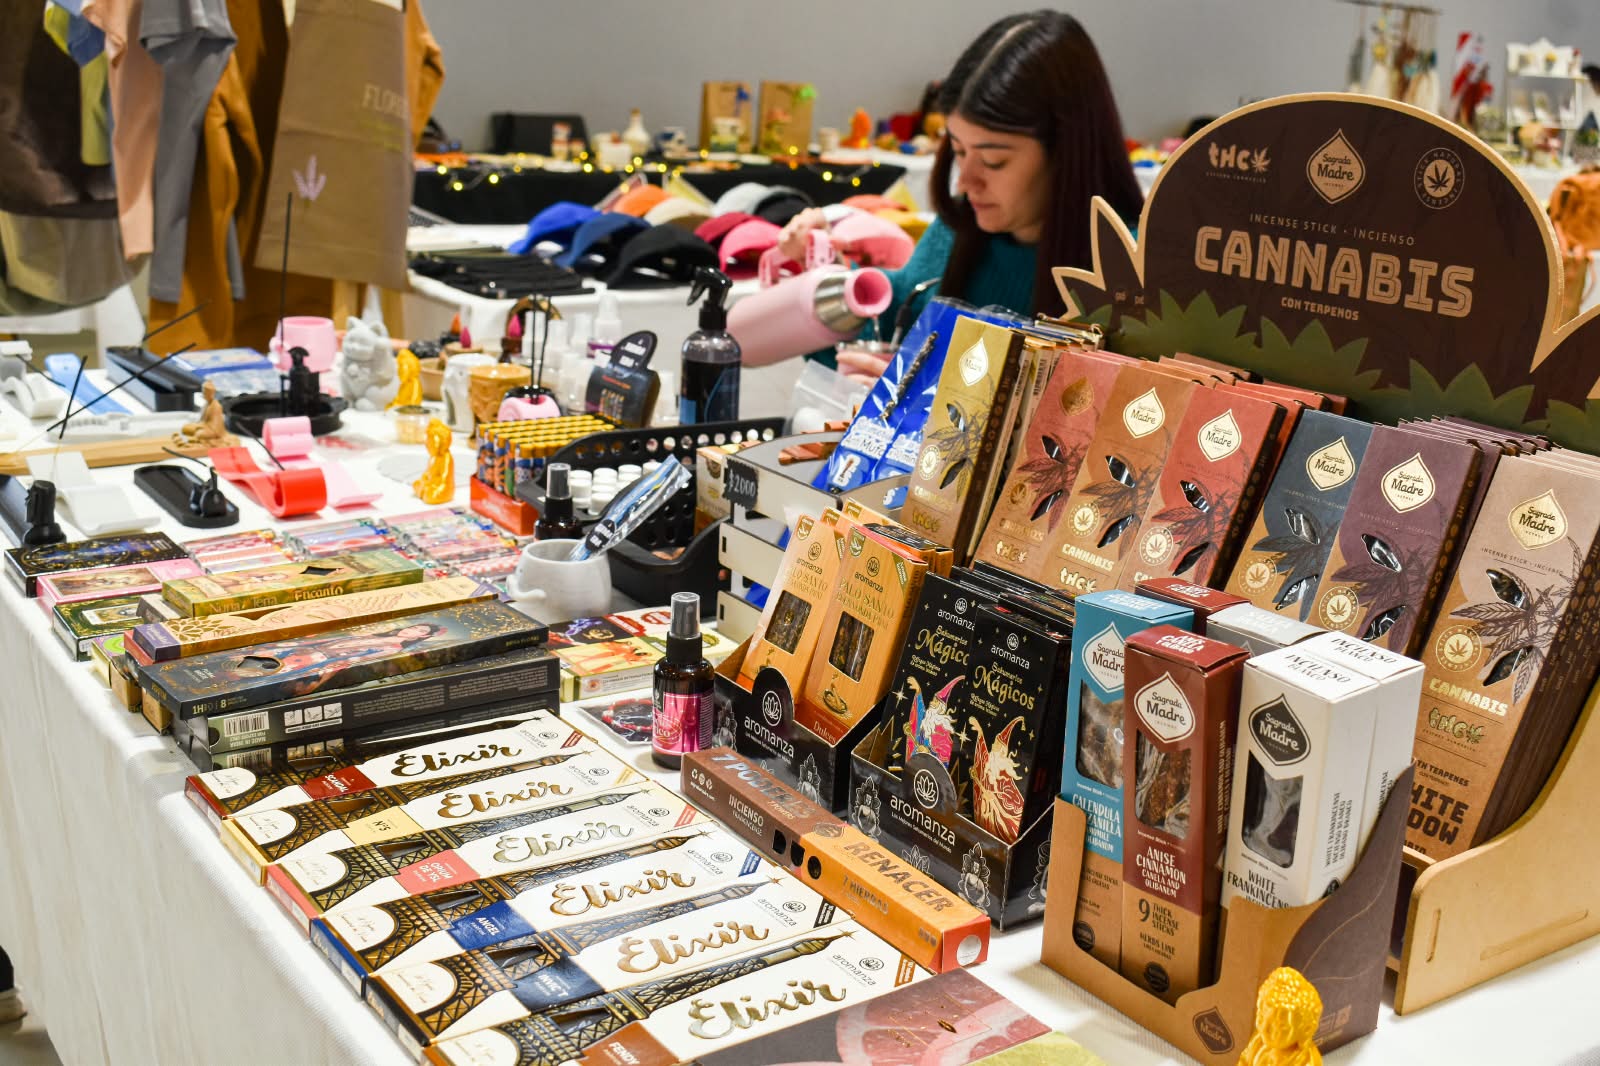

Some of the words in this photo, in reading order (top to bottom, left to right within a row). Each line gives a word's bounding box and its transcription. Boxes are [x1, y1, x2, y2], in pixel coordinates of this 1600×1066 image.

[1317, 164, 1354, 181] Madre
[1250, 213, 1298, 229] INCENSE
[1303, 220, 1338, 234] STICK
[1353, 228, 1415, 246] INCIENSO
[1194, 225, 1475, 318] CANNABIS
[1281, 297, 1301, 310] CON
[1303, 300, 1360, 321] TERPENOS
[1130, 409, 1156, 425] Madre
[1205, 431, 1232, 448] Madre
[1315, 459, 1345, 476] Madre
[727, 472, 757, 498] $2000
[1391, 478, 1424, 497] Madre
[1519, 513, 1556, 534] Madre
[1528, 506, 1555, 521] Sagrada
[1062, 543, 1114, 572] CANNABIS
[855, 571, 884, 593] aromanza
[990, 644, 1030, 670] aromanza
[1092, 651, 1125, 674] Madre
[1285, 654, 1351, 683] INCIENSO
[972, 665, 1035, 710] Mágicos
[1151, 691, 1182, 709] Sagrada
[1429, 677, 1509, 717] CANNABIS
[1146, 700, 1187, 726] Madre
[1265, 712, 1296, 734] Sagrada
[744, 715, 795, 759] aromanza
[813, 720, 836, 745] Dulces
[1259, 720, 1300, 751] Madre
[390, 743, 523, 777] Elixir
[1429, 763, 1470, 787] TERPENES
[437, 781, 574, 819] Elixir
[728, 793, 764, 827] INCIENSO
[1072, 793, 1121, 825] CALENDULA
[1411, 782, 1470, 825] HITE
[890, 794, 956, 847] aromanza
[1407, 807, 1460, 845] DOW
[493, 821, 635, 864] Elixir
[1147, 845, 1176, 868] ANISE
[843, 840, 955, 914] RENACER
[1136, 853, 1187, 886] CINNAMON
[1141, 868, 1166, 886] CANELA
[1166, 877, 1181, 891] AND
[1248, 868, 1276, 895] WHITE
[549, 868, 697, 917] Elixir
[849, 882, 889, 916] HIERBAS
[1227, 871, 1289, 909] FRANKINCENS
[757, 896, 798, 927] aromanza
[1138, 898, 1151, 922] 9
[1153, 903, 1173, 919] THICK
[476, 917, 498, 936] ANGEL
[616, 919, 770, 974] Elixir
[832, 953, 877, 987] aromanza
[687, 978, 847, 1040] Elixir
